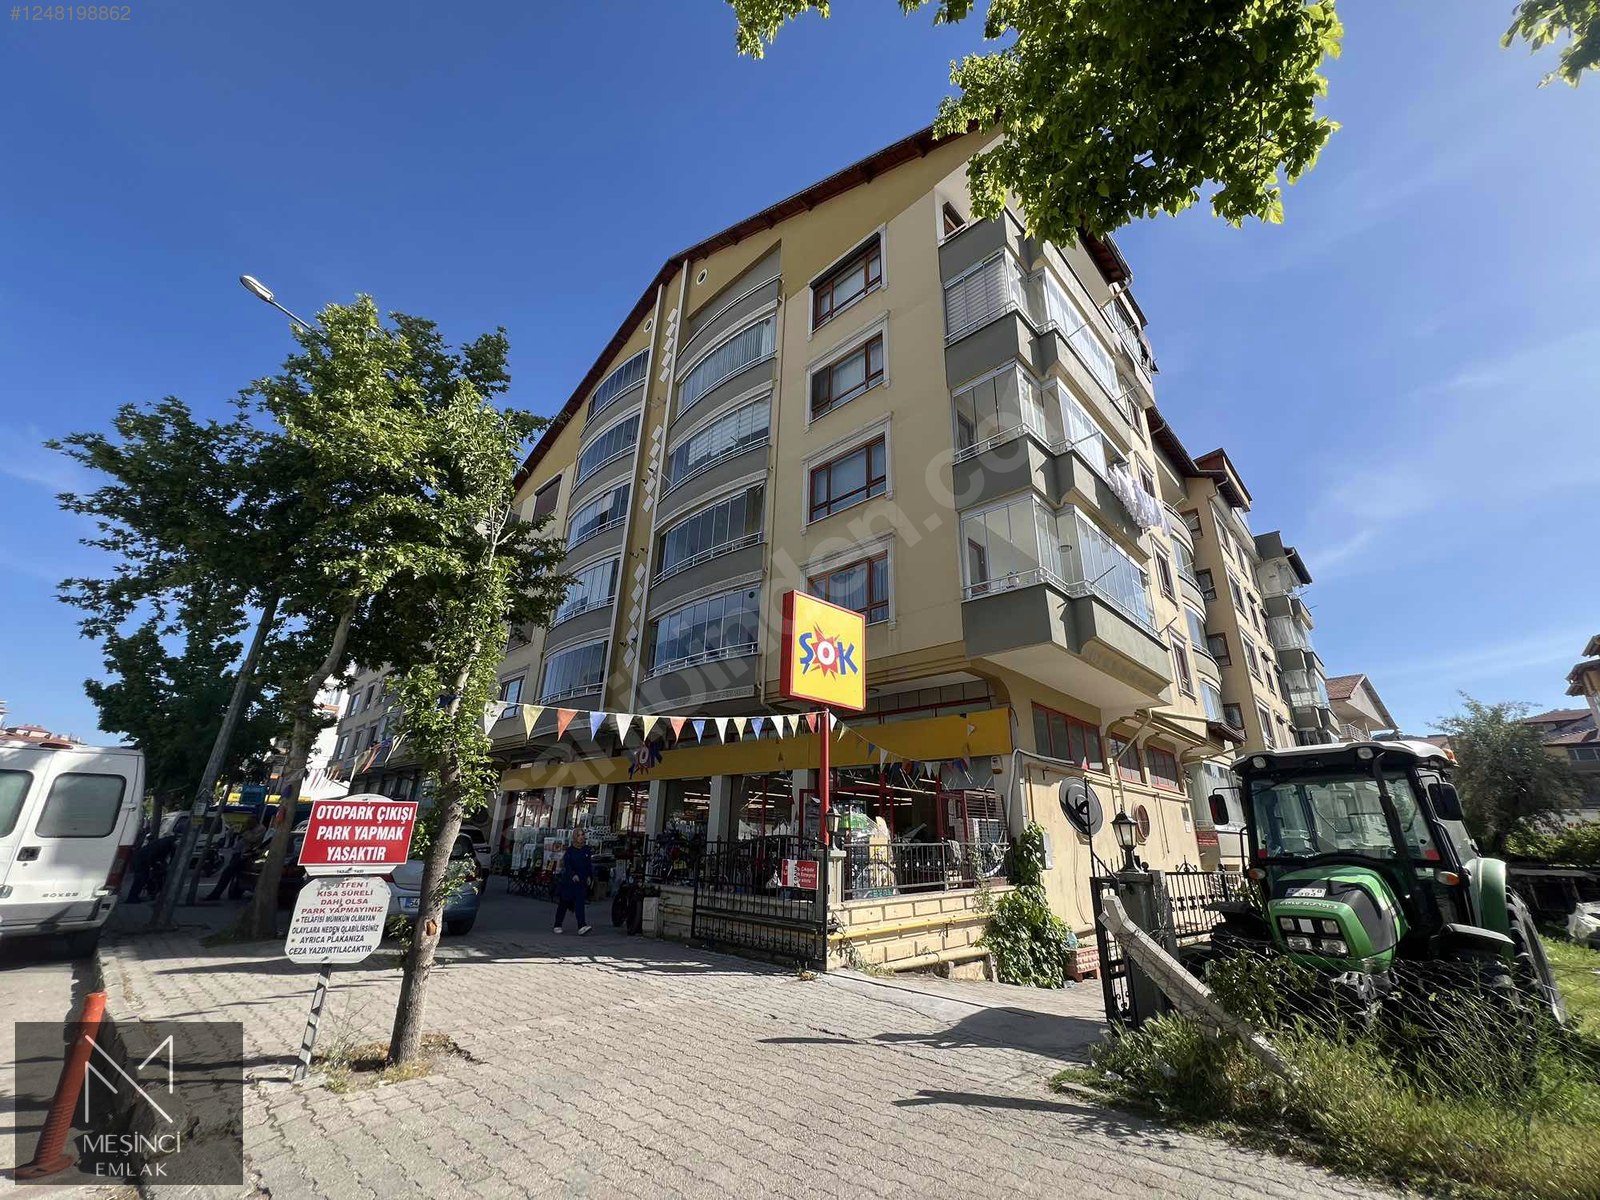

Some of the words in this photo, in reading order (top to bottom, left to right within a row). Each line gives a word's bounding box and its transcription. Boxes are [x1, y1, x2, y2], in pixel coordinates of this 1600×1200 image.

[798, 632, 859, 675] ŞOK
[316, 805, 375, 820] OTOPARK
[376, 806, 414, 824] ÇIKIŞI
[316, 825, 352, 840] PARK
[353, 826, 405, 840] YAPMAK
[326, 846, 387, 861] YASAKTIR
[340, 889, 374, 897] SÜRELİ
[320, 898, 343, 906] DAHİ
[301, 907, 326, 915] PARK
[328, 906, 384, 914] YAPMAYINIZ
[350, 914, 376, 922] OLMAYAN
[291, 926, 321, 935] OLAYLARA
[321, 925, 340, 934] NEDEN
[299, 936, 325, 944] AYRICA
[326, 935, 365, 943] PLAKANIZA
[288, 947, 307, 956] CEZA
[308, 945, 373, 955] YAZDIRTILACAKTIR
